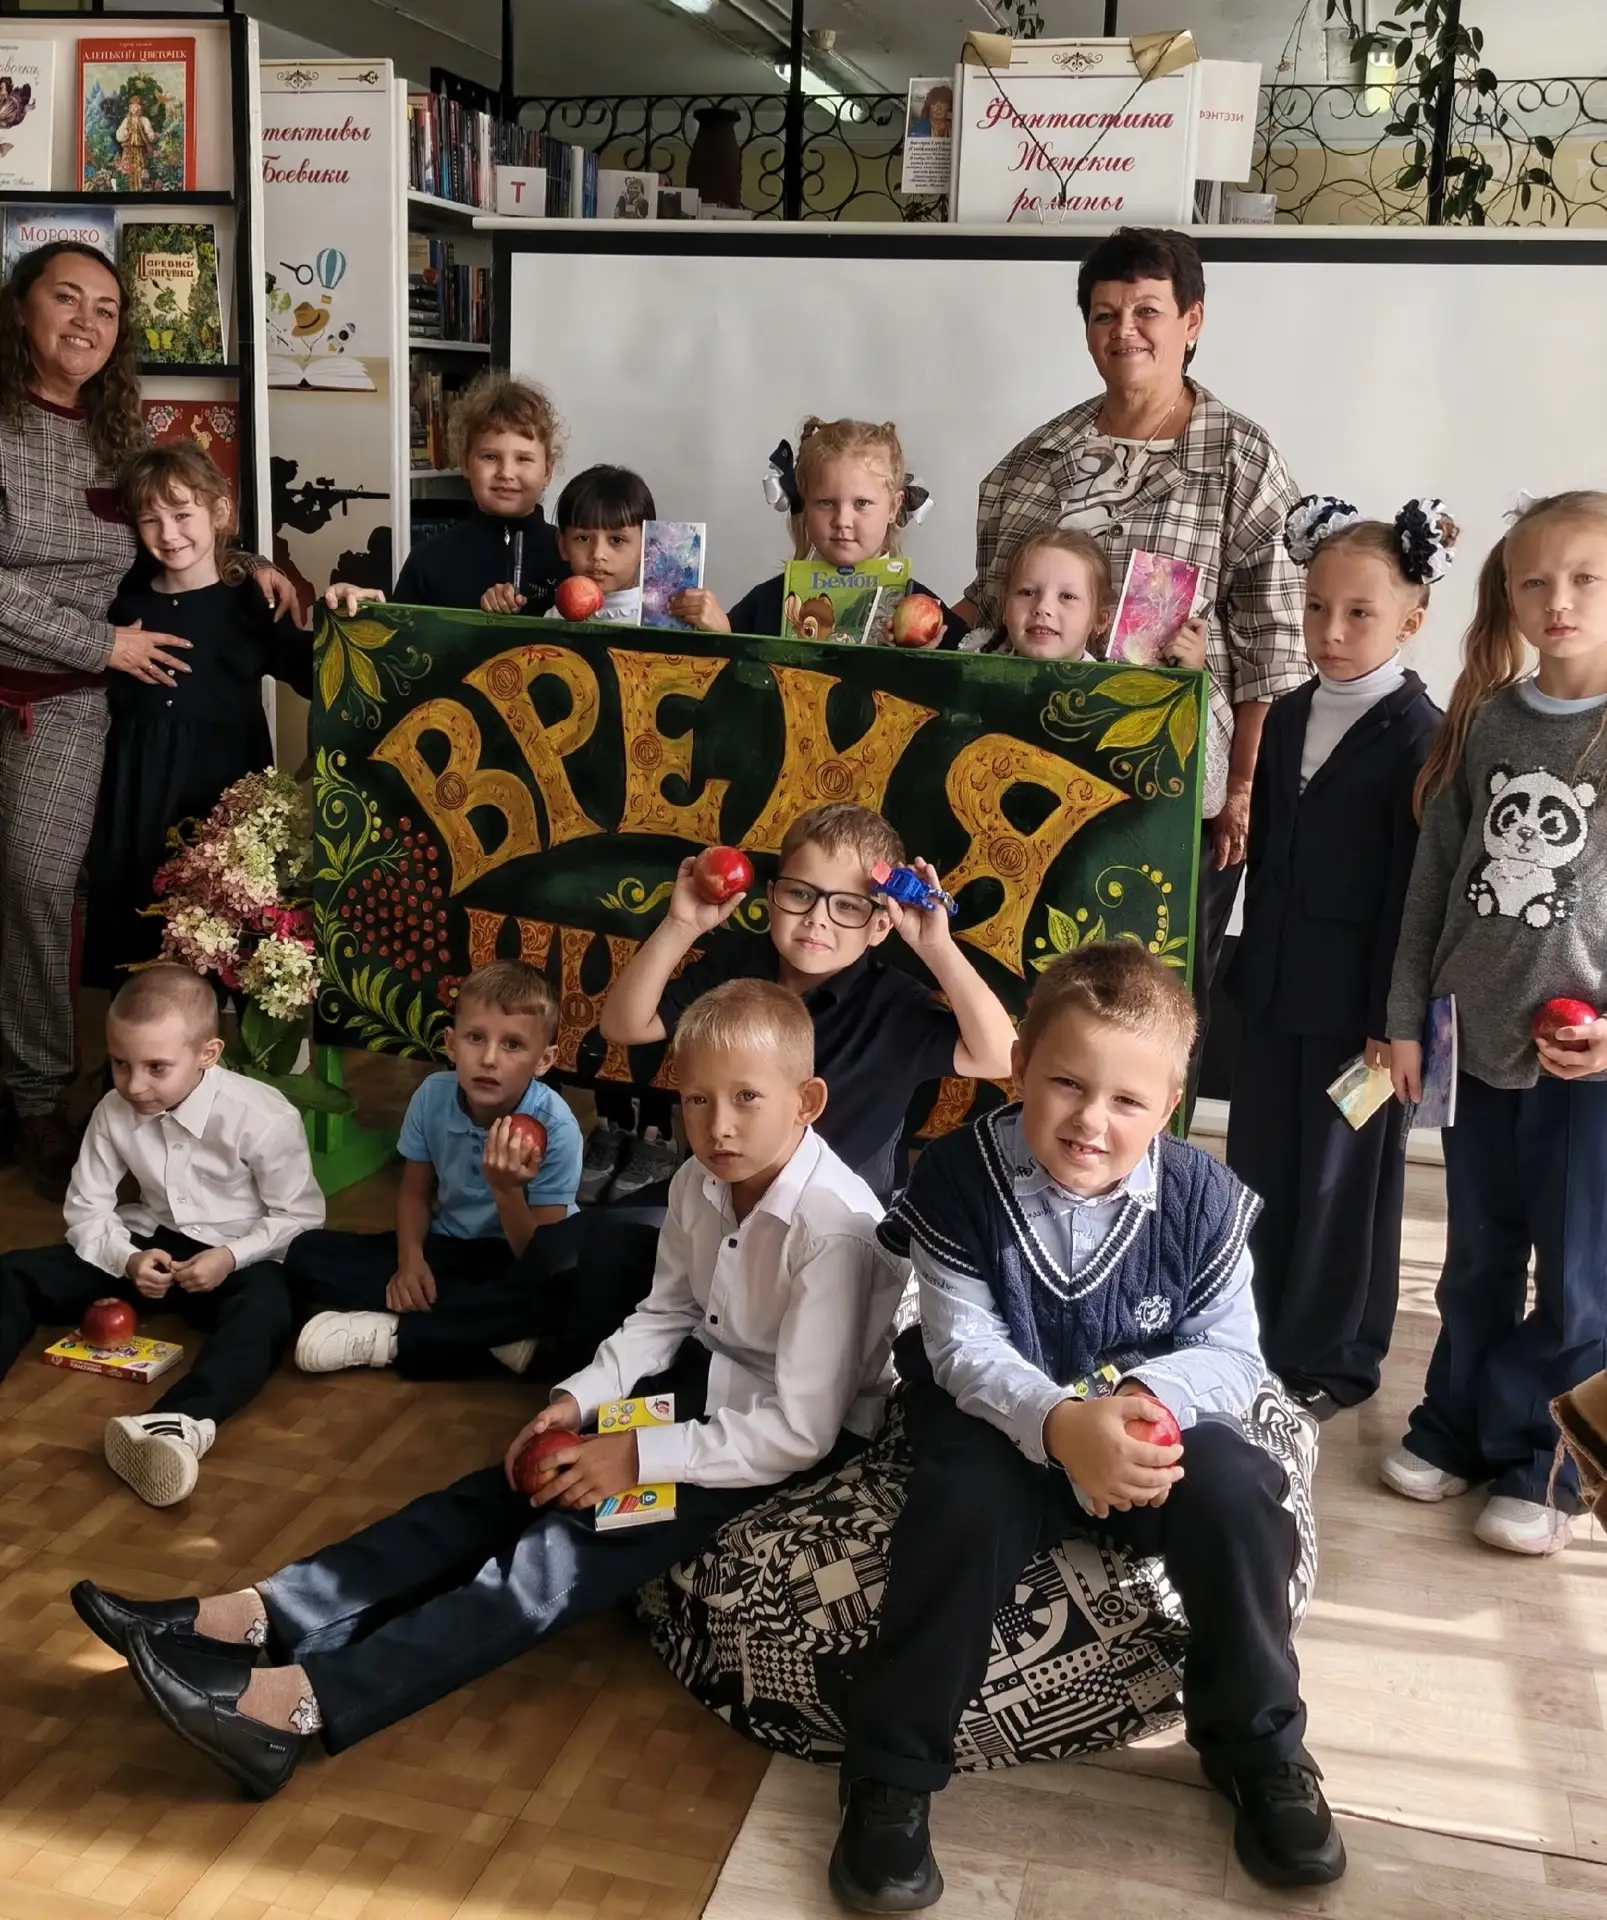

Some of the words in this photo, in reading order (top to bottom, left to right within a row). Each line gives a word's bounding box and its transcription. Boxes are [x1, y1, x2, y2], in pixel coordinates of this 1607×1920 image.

[139, 50, 187, 61] ЦВЕТОЧЕК
[976, 97, 1175, 129] Фантастика
[262, 154, 350, 184] Боевики
[1007, 141, 1136, 172] Женские
[510, 181, 526, 204] Т
[368, 645, 1131, 979] ВРЕМЯ
